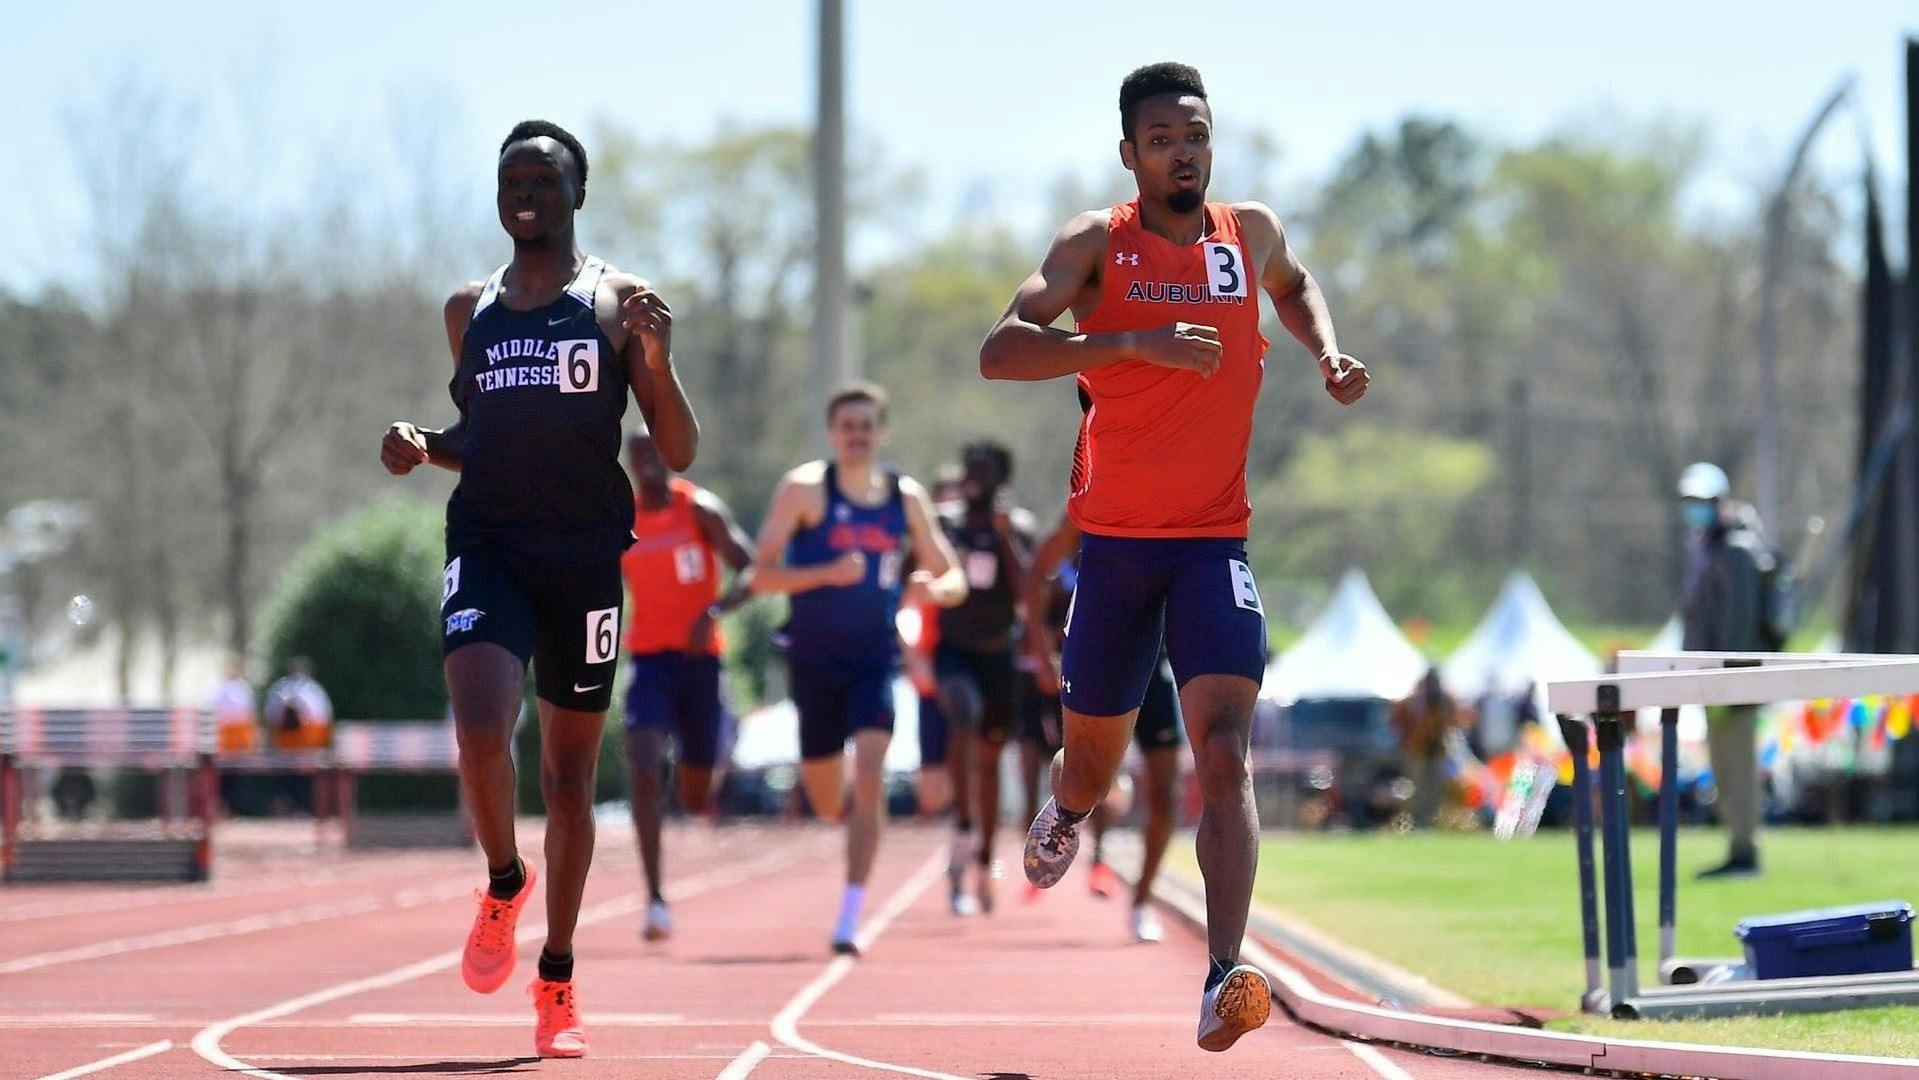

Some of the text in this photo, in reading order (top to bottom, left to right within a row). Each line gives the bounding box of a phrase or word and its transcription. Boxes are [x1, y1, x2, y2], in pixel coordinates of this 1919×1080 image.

[1213, 246, 1239, 293] 3
[485, 338, 558, 366] MIDDLE
[567, 343, 592, 389] 6
[475, 365, 560, 393] TENNESSE
[596, 613, 611, 659] 6
